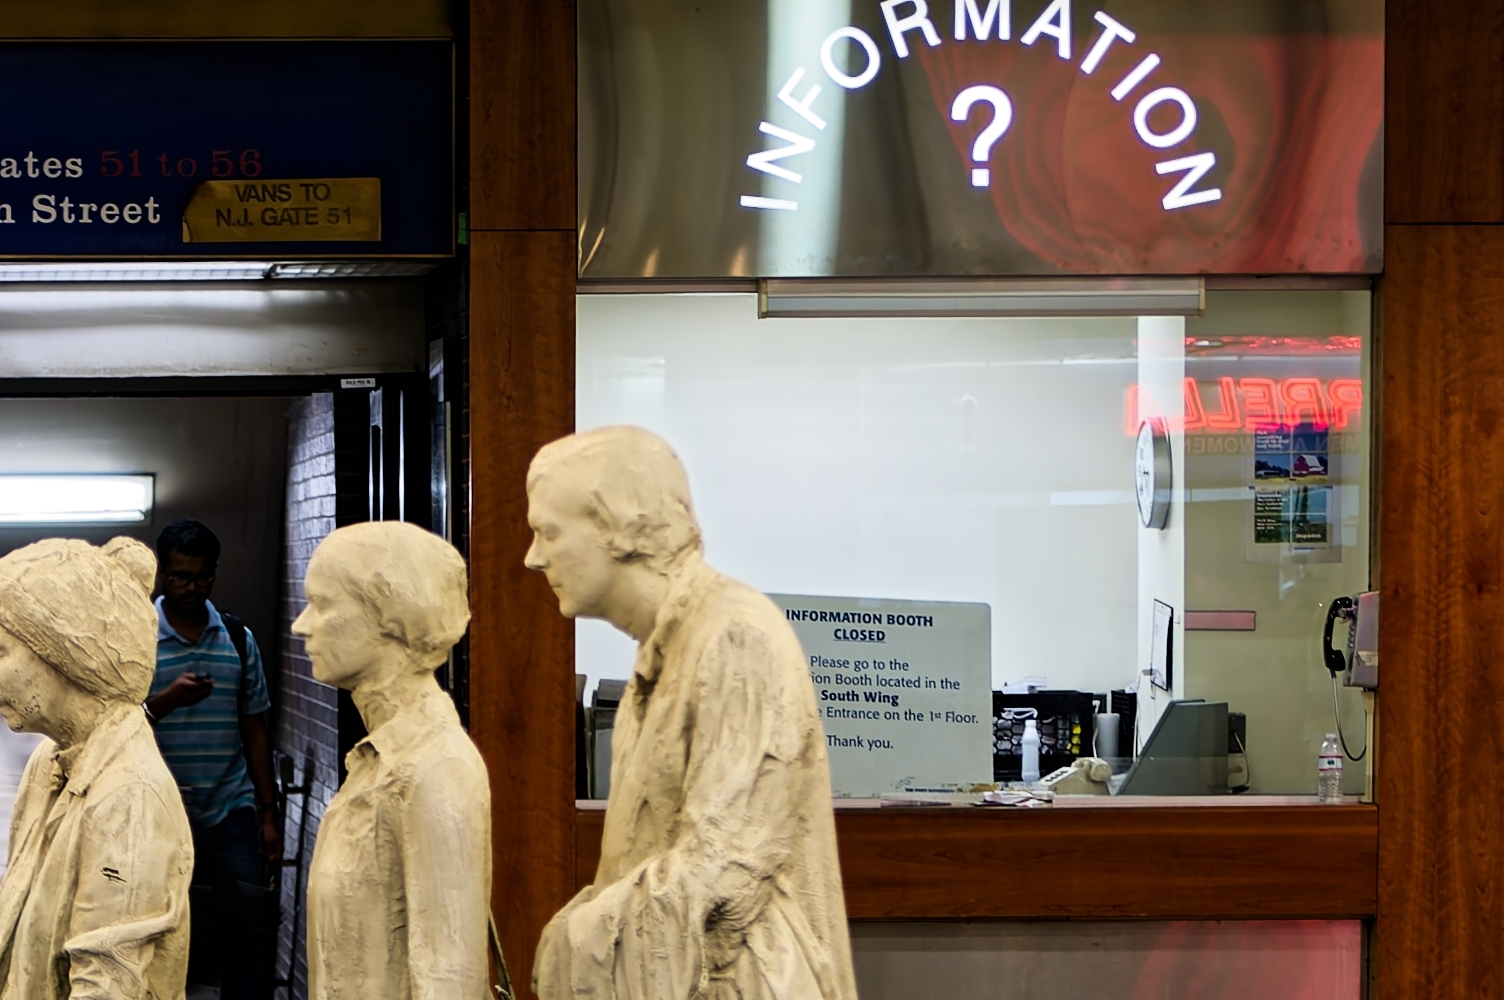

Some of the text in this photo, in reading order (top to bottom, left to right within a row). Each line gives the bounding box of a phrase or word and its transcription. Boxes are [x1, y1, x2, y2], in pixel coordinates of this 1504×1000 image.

[739, 0, 1223, 212] INFORMATION
[101, 150, 143, 178] 51
[160, 153, 198, 178] to
[210, 149, 263, 178] 56
[233, 182, 332, 204] VANS TO
[31, 195, 162, 224] Street
[215, 206, 353, 228] N.J. GATE 51
[786, 609, 933, 627] INFORMATION BOOTH
[833, 628, 886, 642] CLOSED
[810, 656, 909, 673] Please go to the
[836, 674, 872, 687] Booth
[876, 675, 921, 689] located
[925, 677, 936, 689] in
[940, 677, 960, 690] the
[821, 690, 899, 707] South Wing
[826, 707, 880, 720] Entrance
[884, 711, 900, 721] on
[904, 709, 924, 722] the
[945, 710, 979, 725] Floor.
[826, 734, 894, 751] Thank you.
